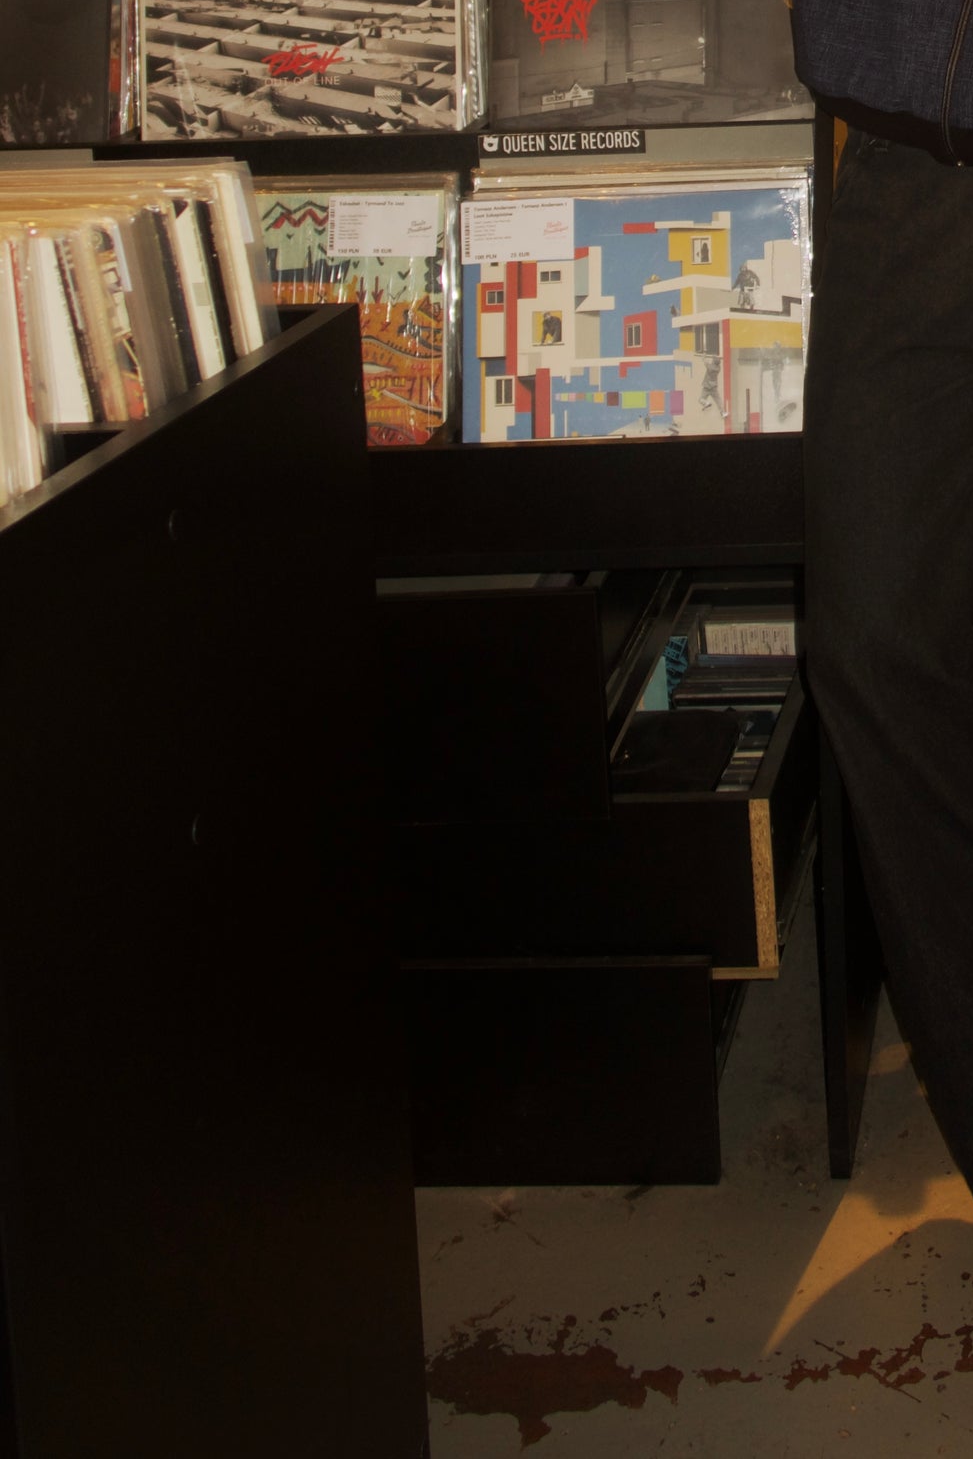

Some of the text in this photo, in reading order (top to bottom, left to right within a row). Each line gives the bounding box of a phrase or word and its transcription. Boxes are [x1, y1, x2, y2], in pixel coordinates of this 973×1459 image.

[264, 74, 341, 86] OUT OF LINE
[502, 131, 640, 154] QUEEN SIZE RECORDS
